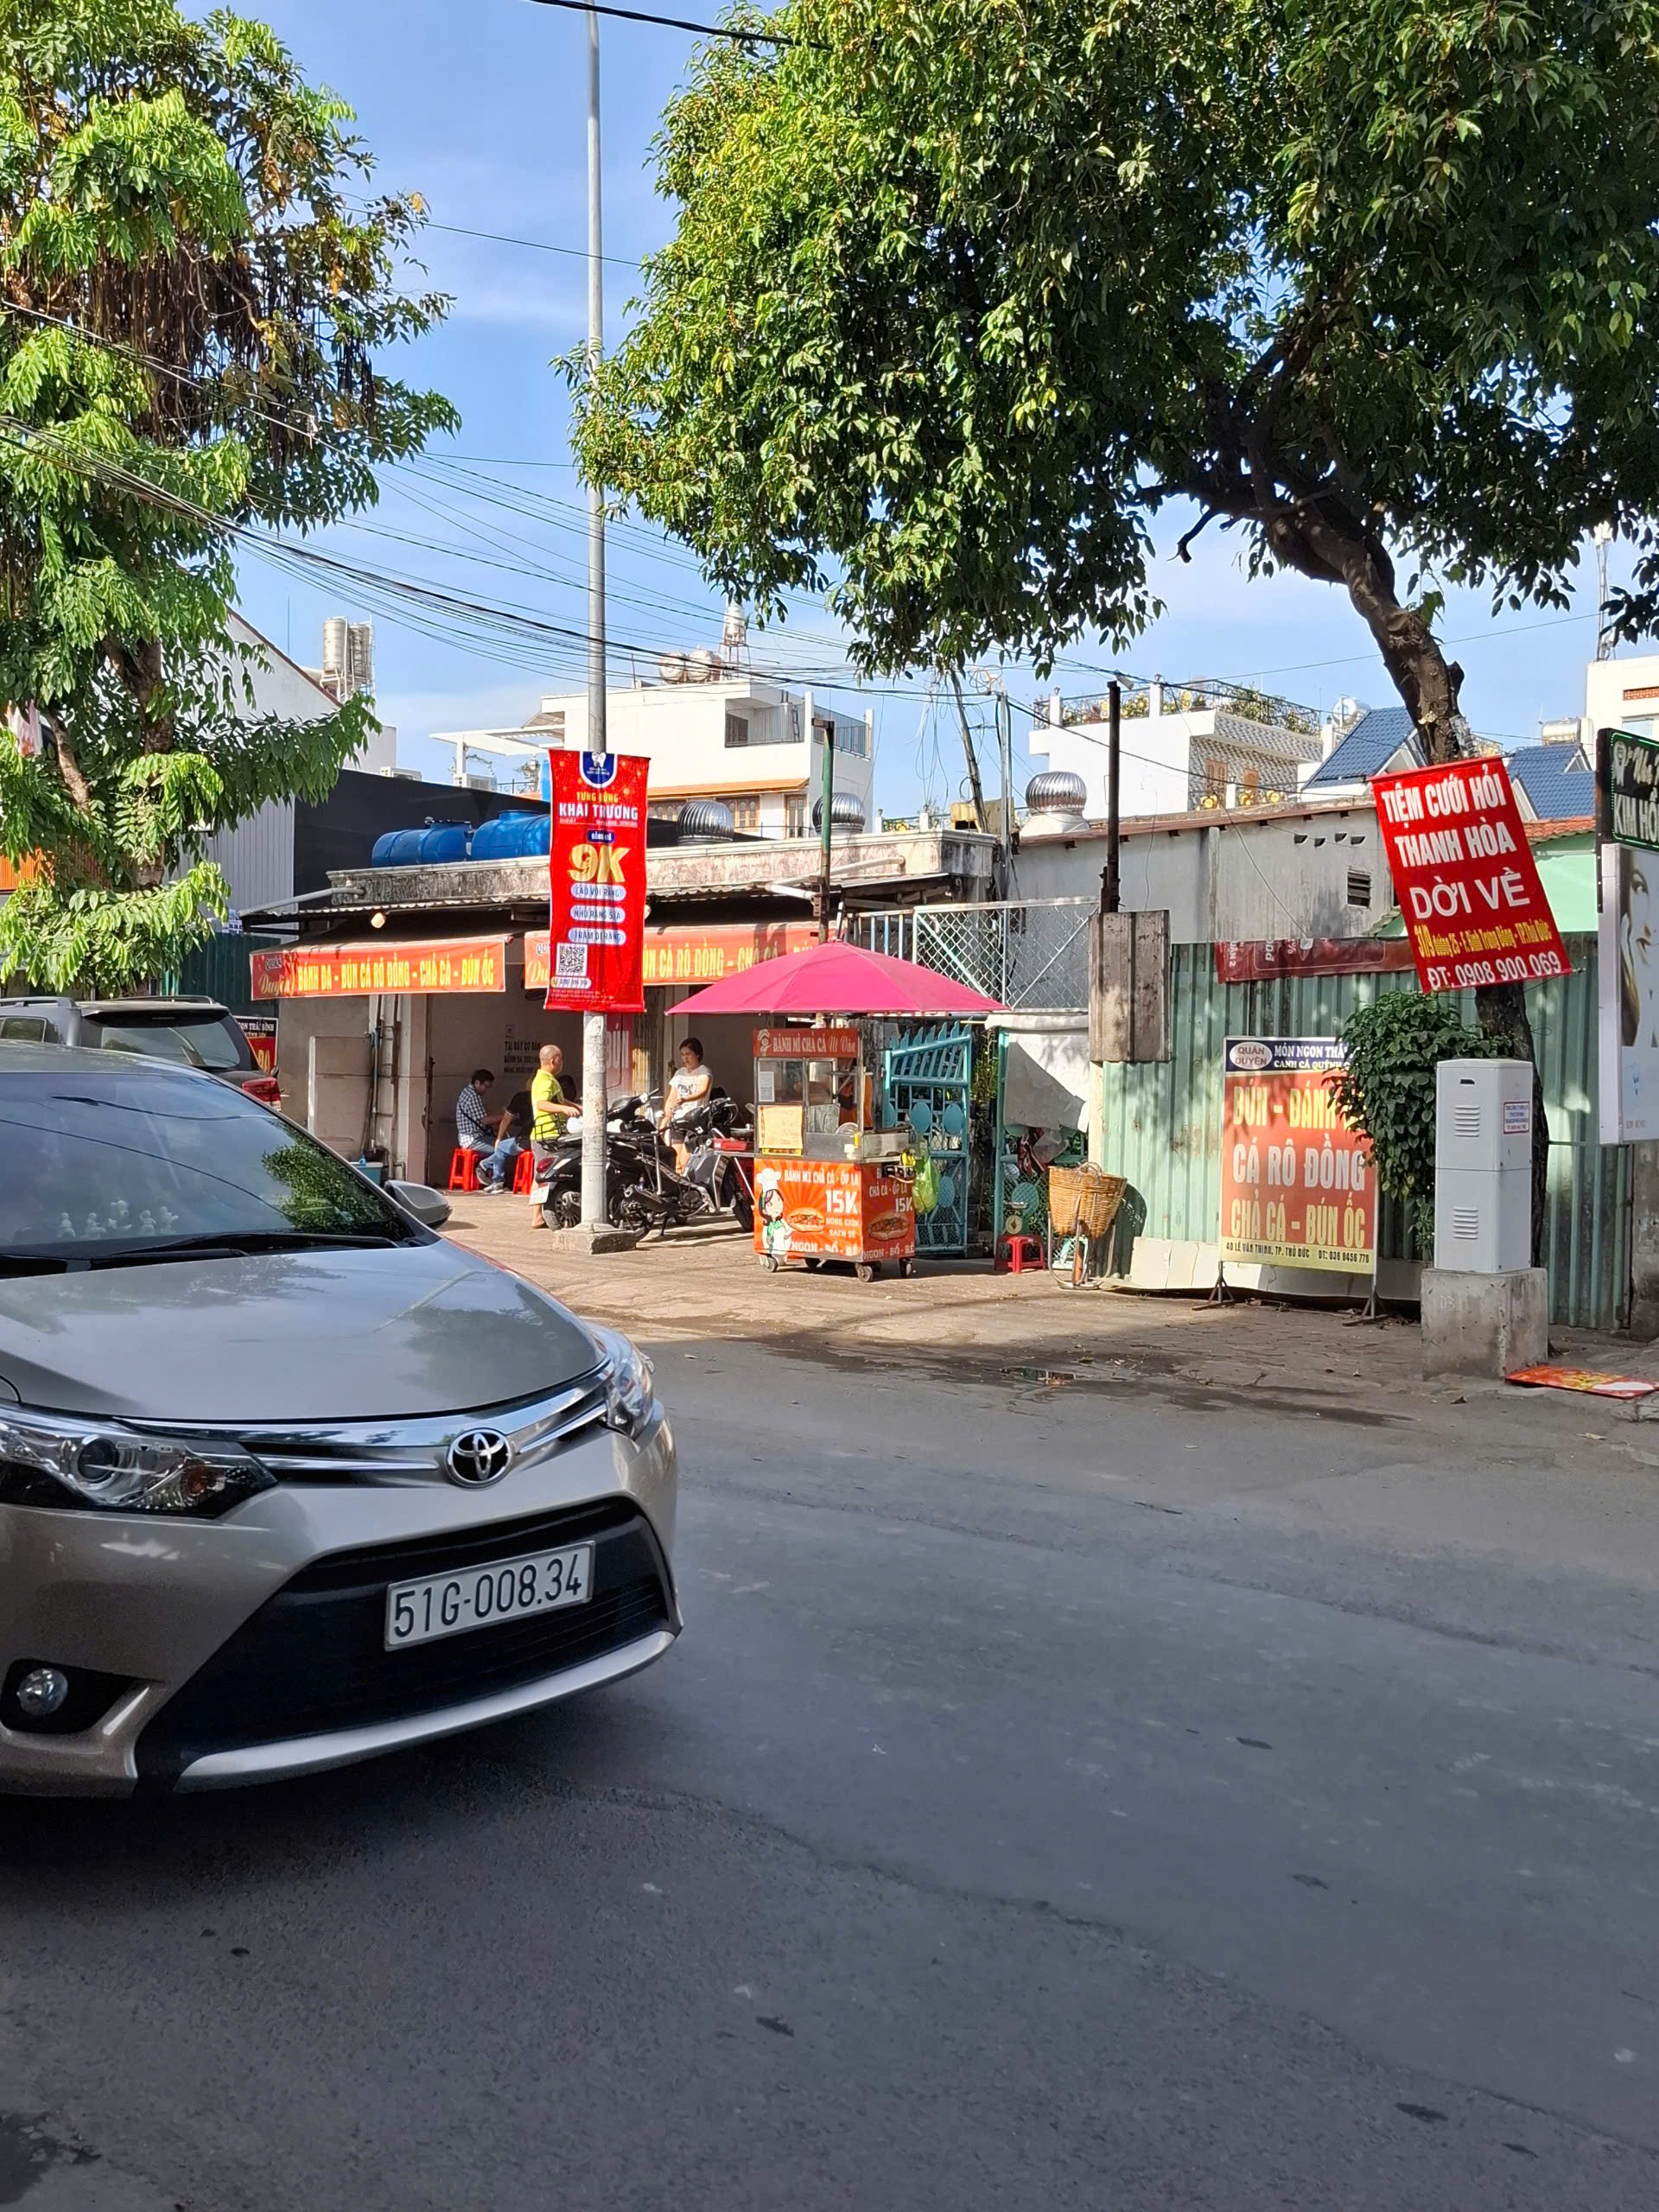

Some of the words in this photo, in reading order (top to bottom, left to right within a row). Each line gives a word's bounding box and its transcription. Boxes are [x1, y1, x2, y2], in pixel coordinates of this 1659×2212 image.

[559, 803, 588, 817] KHAI
[1381, 782, 1424, 829] TIỆM
[1425, 774, 1469, 817] CƯỚI
[1469, 764, 1507, 810] HỎI
[1394, 829, 1464, 868] THANH
[1464, 817, 1517, 859] HÒA
[567, 843, 632, 883] 9K
[1409, 875, 1471, 919] DỜI
[1474, 867, 1530, 910] VỀ
[298, 961, 319, 991] BÁNH
[341, 958, 358, 989] BÚN
[360, 957, 372, 988] CÁ
[440, 954, 451, 986] CÁ
[461, 954, 480, 986] BÚN
[659, 944, 673, 978] CÁ
[1455, 961, 1495, 987] 0908
[1496, 956, 1529, 982] 900
[1529, 950, 1561, 976] 069
[773, 1033, 791, 1052] BÁNH
[817, 1033, 826, 1052] CÁ
[1237, 1045, 1265, 1055] QUÁN
[1274, 1043, 1294, 1058] MÓN
[1296, 1046, 1323, 1058] NGON
[1274, 1059, 1297, 1069] CANH
[1299, 1058, 1310, 1069] CÁ
[1233, 1078, 1268, 1127] BÚN
[1232, 1136, 1260, 1185] CÁ
[1268, 1138, 1296, 1187] RÔ
[1304, 1133, 1365, 1192] ĐỒNG
[826, 1190, 858, 1214] 15K
[895, 1197, 912, 1212] 15K
[1231, 1188, 1261, 1239] CHẢ
[1266, 1194, 1286, 1242] CÁ
[1306, 1197, 1338, 1246] BÚN
[1344, 1192, 1365, 1249] ỐC
[791, 1241, 818, 1252] NGON
[394, 1554, 582, 1637] 51G-008.34
